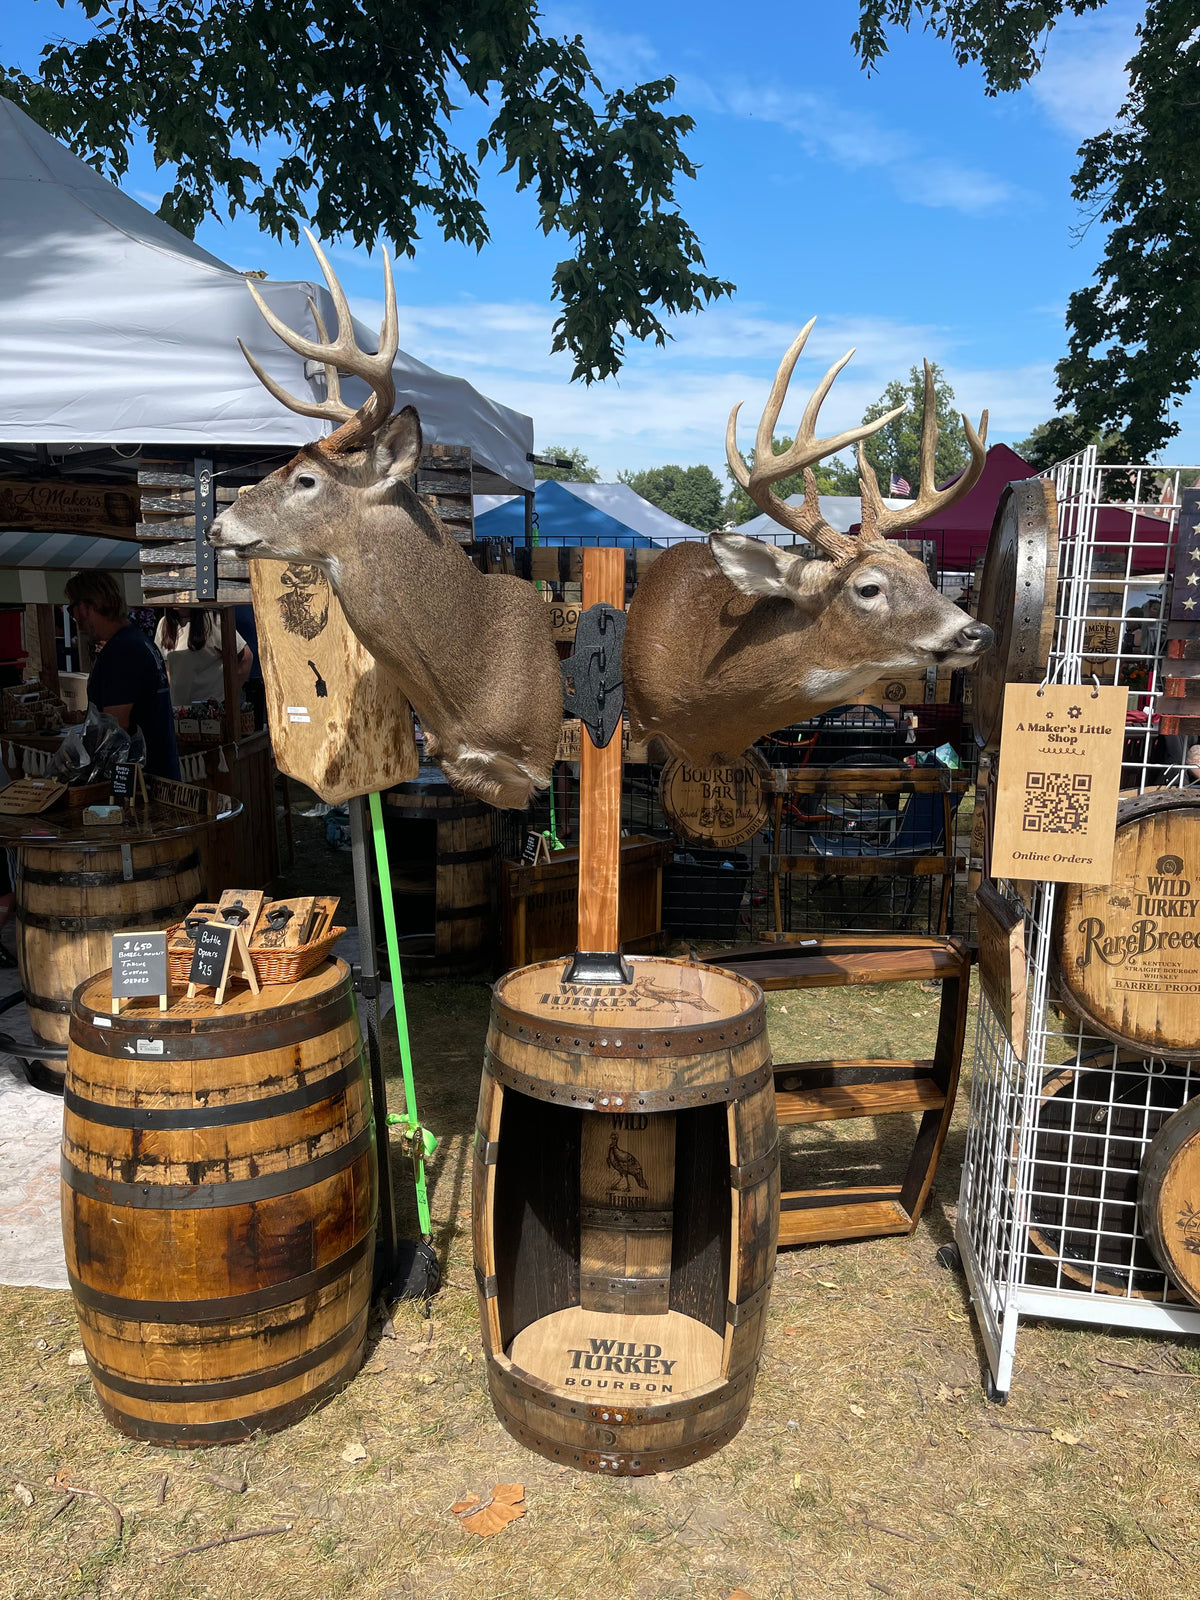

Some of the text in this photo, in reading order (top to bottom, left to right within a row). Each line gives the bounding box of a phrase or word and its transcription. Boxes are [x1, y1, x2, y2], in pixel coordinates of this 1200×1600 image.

[15, 487, 100, 507] A Maker's
[1016, 723, 1112, 735] A Maker's Little
[1047, 734, 1078, 745] Shop
[682, 765, 756, 787] BOURBON
[700, 783, 737, 800] BAR
[721, 818, 763, 846] HAPPY HOUR
[1012, 851, 1094, 865] Online Orders
[1147, 876, 1191, 897] WILD
[1134, 894, 1200, 918] TURKEY
[201, 931, 221, 946] Bottle
[134, 942, 152, 951] 650
[197, 948, 218, 958] Openers
[558, 984, 627, 997] WILD
[1115, 980, 1162, 991] BARREL
[534, 992, 642, 1007] TURKEY
[612, 1113, 648, 1130] WILD
[588, 1338, 662, 1358] WILD
[566, 1349, 677, 1375] TURKEY
[564, 1377, 673, 1392] BOURBON
